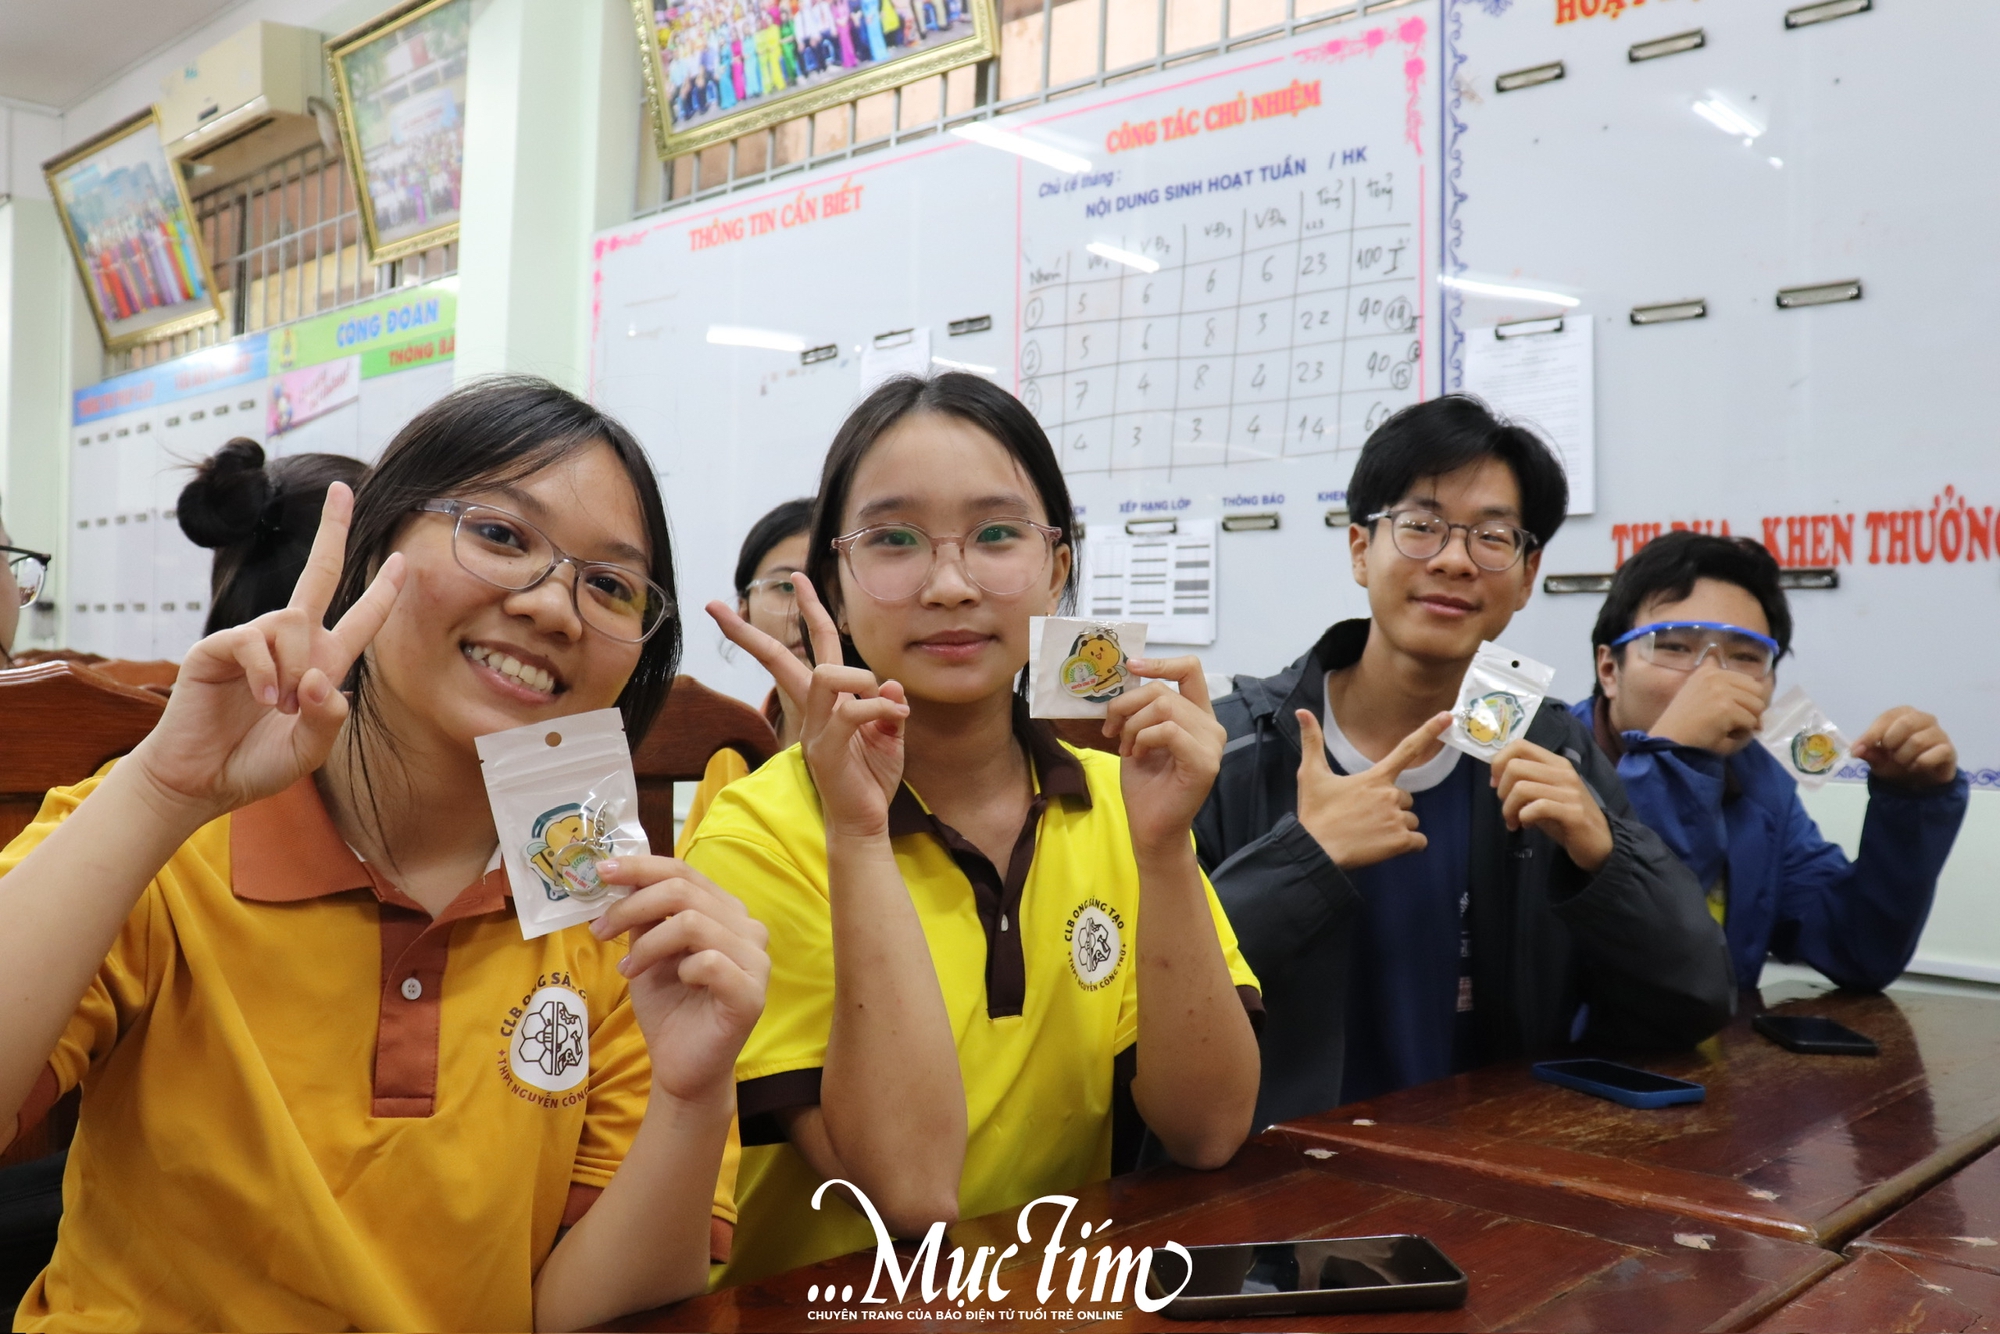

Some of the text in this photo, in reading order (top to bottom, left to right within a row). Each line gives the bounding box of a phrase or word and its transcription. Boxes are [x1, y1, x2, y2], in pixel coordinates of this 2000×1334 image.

[1106, 78, 1322, 153] CÔNG TÁC CHỦ NHIỆM
[1085, 196, 1112, 218] NỘI
[1115, 189, 1160, 212] DUNG
[1164, 180, 1203, 201] SINH
[1207, 168, 1254, 192] HOẠT
[1342, 145, 1368, 166] HK
[688, 217, 745, 252] THÔNG
[748, 208, 777, 237] TIN
[822, 175, 866, 219] BIẾT
[1077, 292, 1087, 314] 5
[1143, 283, 1153, 303] 6
[1206, 269, 1216, 293] 6
[1262, 255, 1274, 282] 6
[1302, 252, 1328, 275] 23
[335, 295, 439, 349] CÔNG ĐOÀN
[1079, 335, 1090, 359] 5
[1257, 312, 1268, 336] 3
[1300, 310, 1330, 330] 22
[388, 341, 435, 367] THÔNG
[1075, 380, 1088, 410] 7
[1138, 373, 1151, 396] 4
[1296, 361, 1324, 384] 23
[1132, 427, 1141, 447] 3
[1191, 418, 1202, 443] 3
[1247, 414, 1260, 442] 4
[1298, 415, 1325, 442] 14
[1222, 491, 1285, 507] THÔNG BÁO
[1761, 483, 2000, 568] KHEN THƯỞN
[1064, 919, 1076, 942] CLB
[1072, 899, 1088, 919] ONG
[1108, 907, 1125, 930] TẠO
[1068, 957, 1079, 980] THPT
[1100, 969, 1119, 989] CÔNG
[500, 1006, 523, 1037] CLB
[522, 974, 547, 1007] ONG
[498, 1058, 589, 1108] THPT NGUYỄN CÔNG
